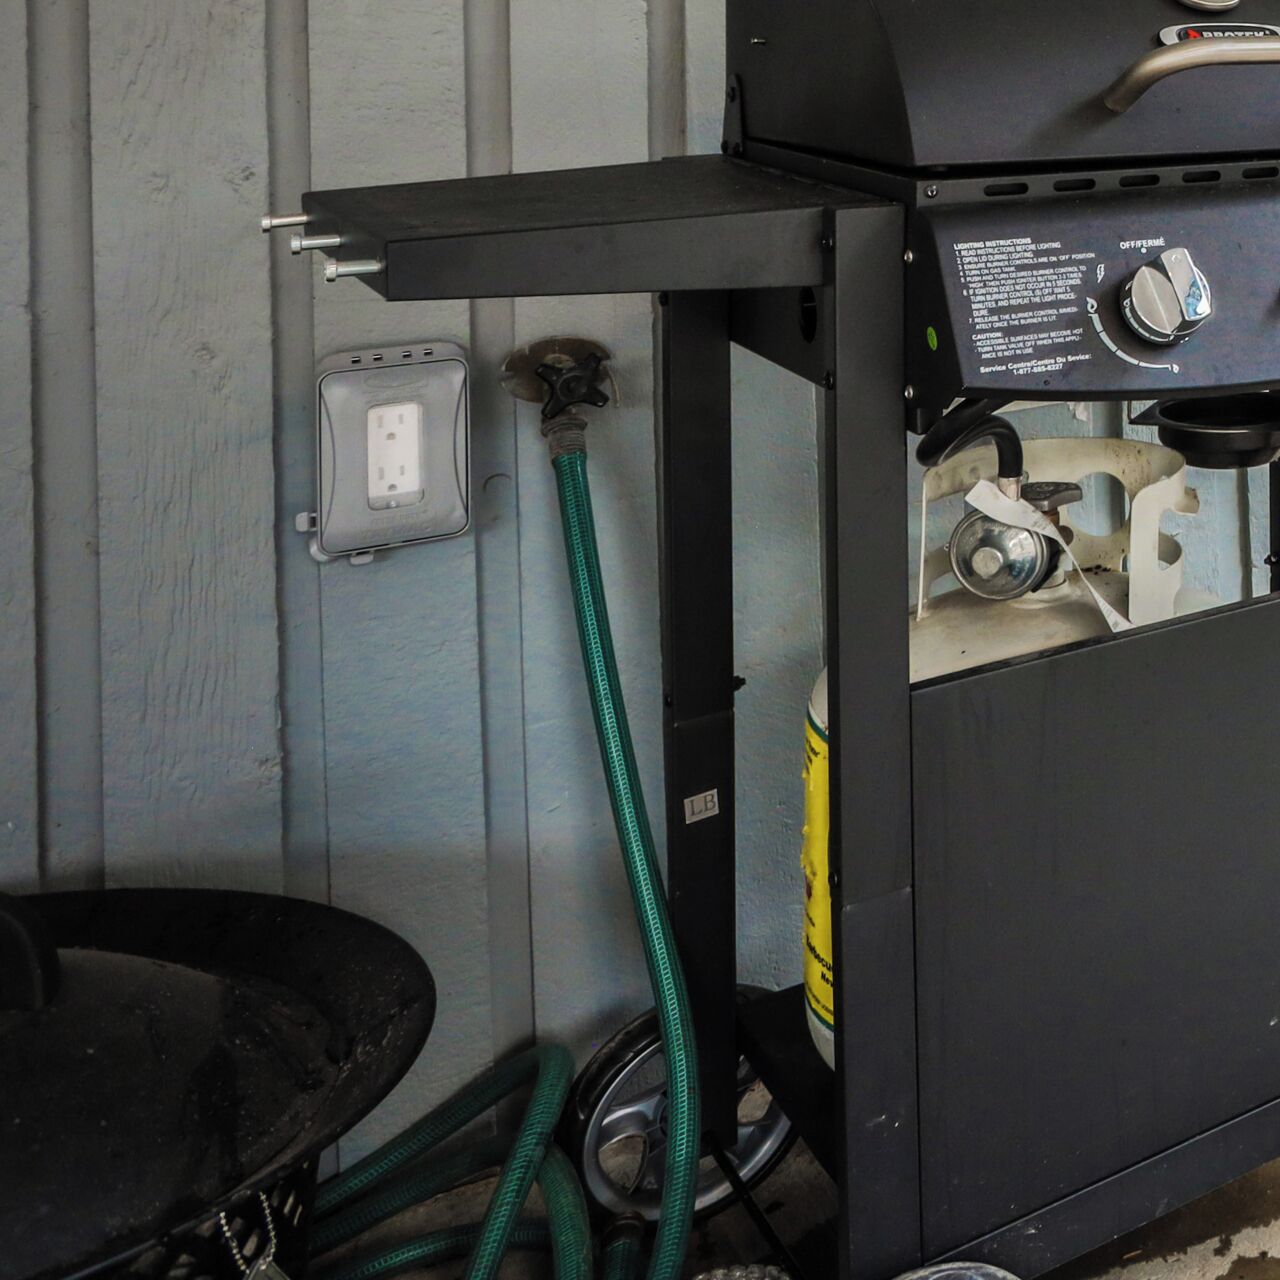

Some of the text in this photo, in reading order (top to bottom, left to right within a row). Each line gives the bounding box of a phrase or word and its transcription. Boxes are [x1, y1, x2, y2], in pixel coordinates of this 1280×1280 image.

[953, 238, 1031, 250] LIGHTING INSTRUCTIONS
[977, 246, 1015, 255] INSTRUCTIONS
[1015, 244, 1036, 252] BEFORE
[1009, 290, 1034, 298] CONTROL
[974, 315, 999, 323] RELEASE
[1020, 317, 1042, 325] BURNER
[1010, 334, 1038, 342] SURFACES
[980, 365, 1006, 373] Service
[1008, 359, 1055, 369] Centre/Centre
[689, 794, 716, 816] LB
